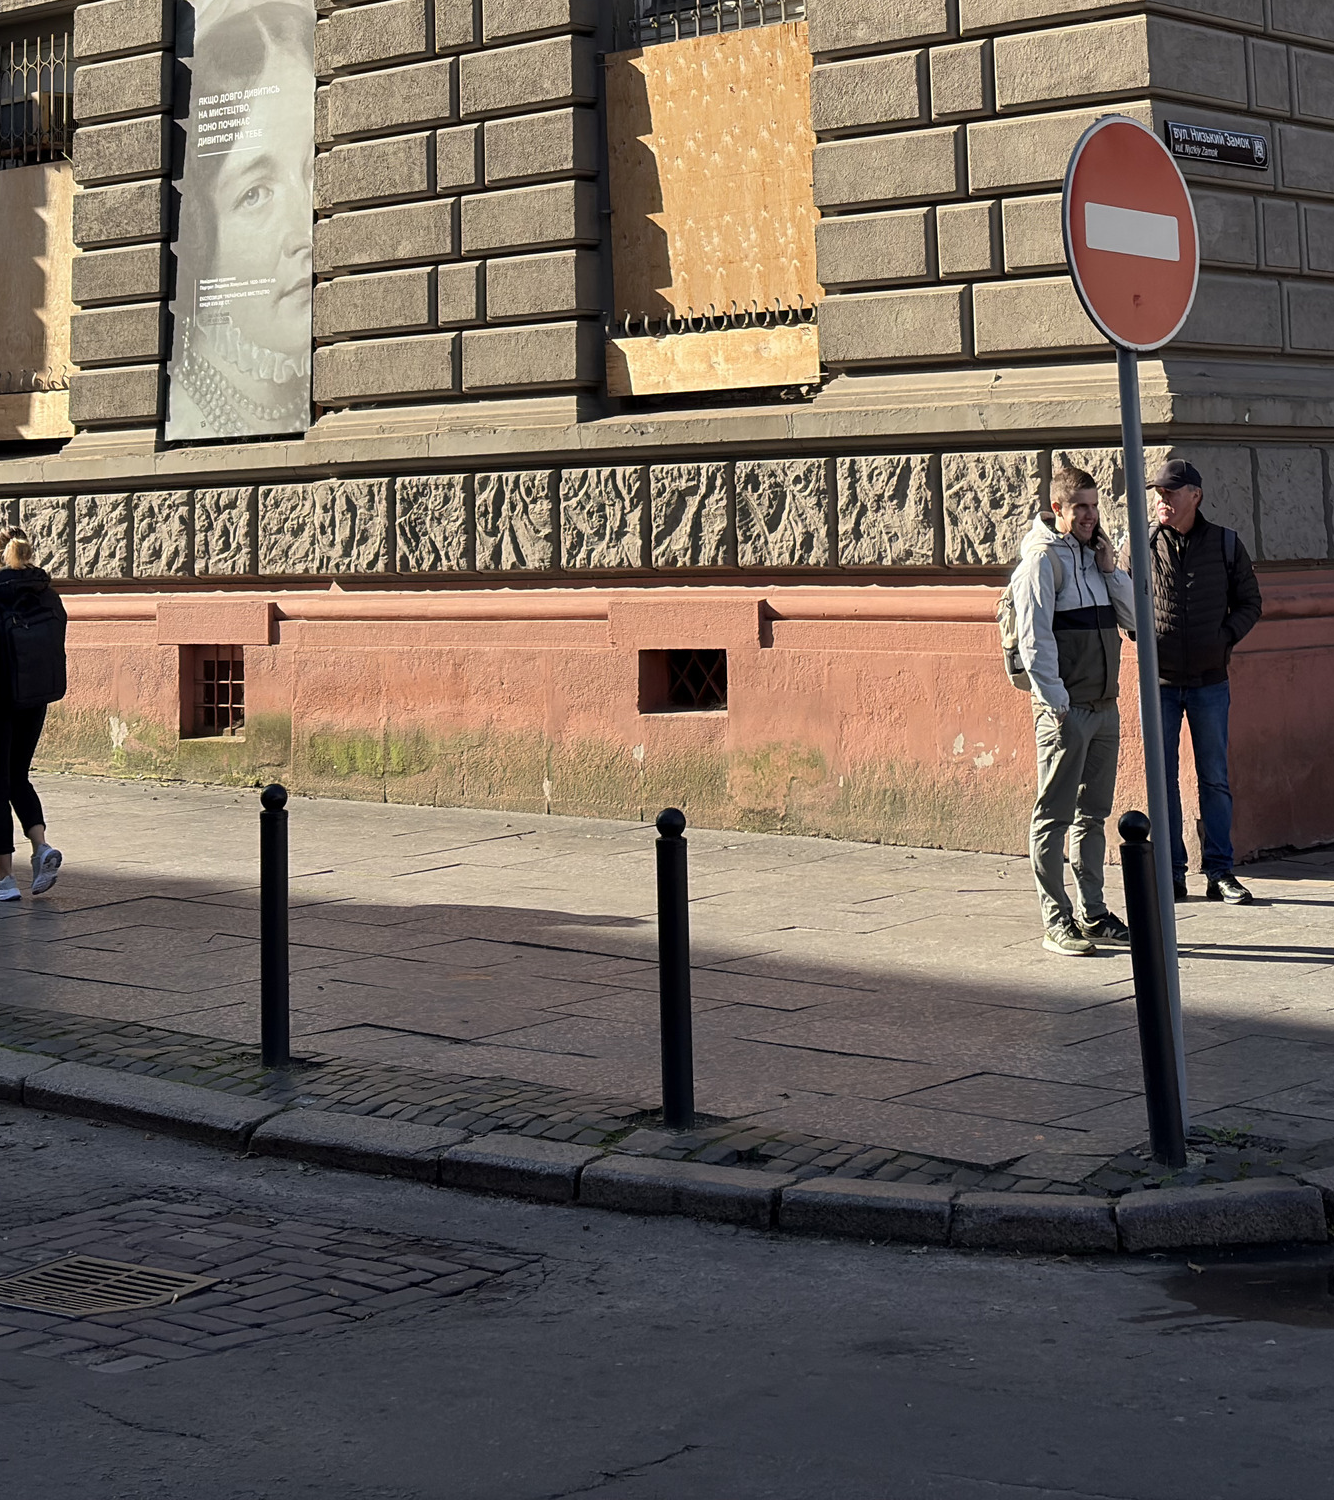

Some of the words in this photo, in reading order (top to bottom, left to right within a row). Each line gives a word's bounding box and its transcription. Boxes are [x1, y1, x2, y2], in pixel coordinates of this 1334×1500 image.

[198, 96, 218, 106] ЯКЩО
[220, 92, 242, 104] ДОВГО
[244, 86, 280, 100] ДИВИТИСЬ
[198, 110, 208, 120] НА
[208, 104, 250, 118] МИСТЕЦТВО,
[198, 122, 218, 132] ВОНО
[218, 116, 250, 130] ПОЧИНАЄ
[198, 134, 234, 148] ДИВИТИСЯ
[234, 132, 244, 140] НА
[246, 128, 262, 138] ТЕБЕ
[1174, 128, 1190, 142] вул.
[1190, 128, 1224, 146] Низький
[1224, 134, 1250, 148] Замок
[1202, 146, 1218, 158] Zamok
